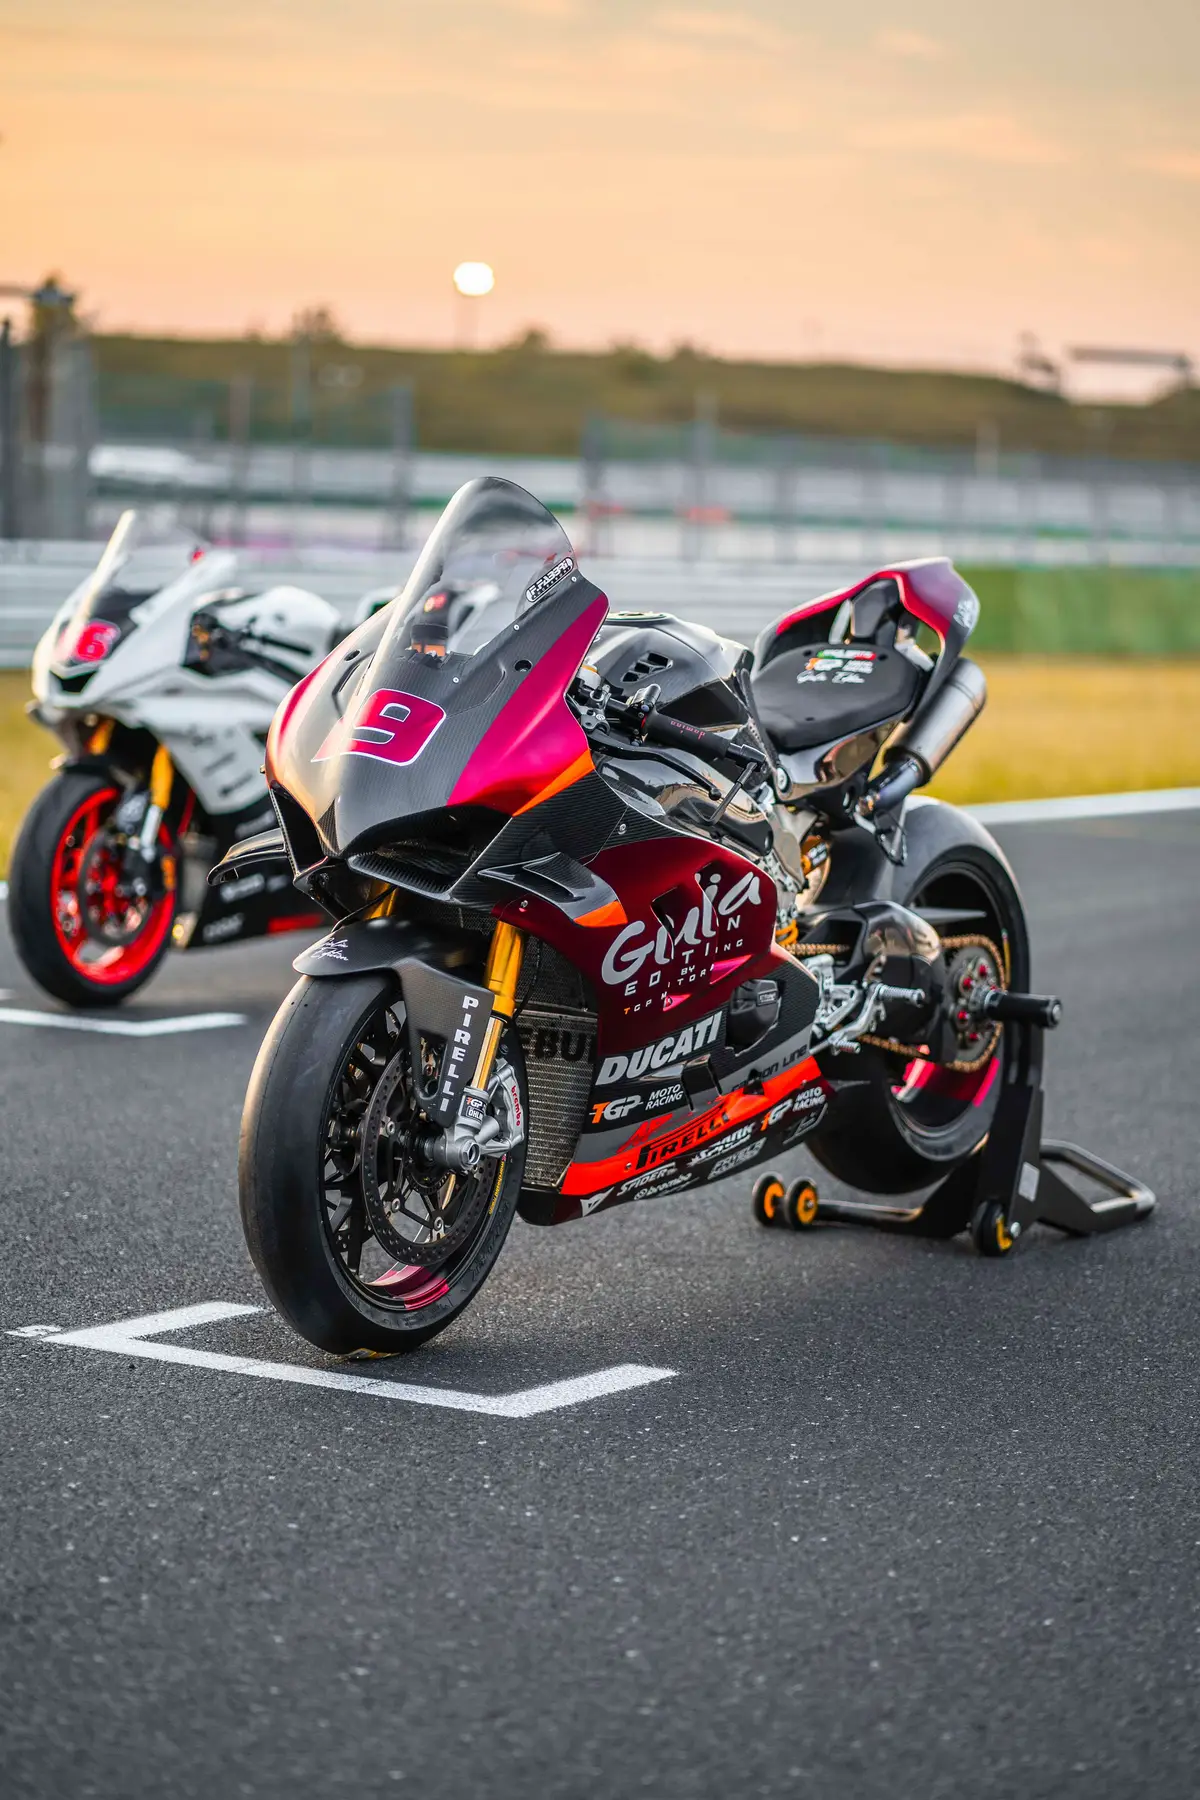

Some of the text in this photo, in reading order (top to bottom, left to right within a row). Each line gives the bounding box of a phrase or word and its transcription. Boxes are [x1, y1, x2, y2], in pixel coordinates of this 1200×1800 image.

[310, 687, 448, 767] 9
[624, 914, 741, 996] EDTIN
[680, 965, 696, 976] BY
[623, 998, 653, 1015] TGP
[440, 995, 479, 1112] PIRELLI
[595, 1010, 723, 1086] DUCATI
[511, 1085, 522, 1127] brembo
[645, 1090, 684, 1111] RACING
[648, 1083, 680, 1101] MOTO
[795, 1086, 822, 1103] MOTO
[616, 1161, 676, 1197] SPIDER
